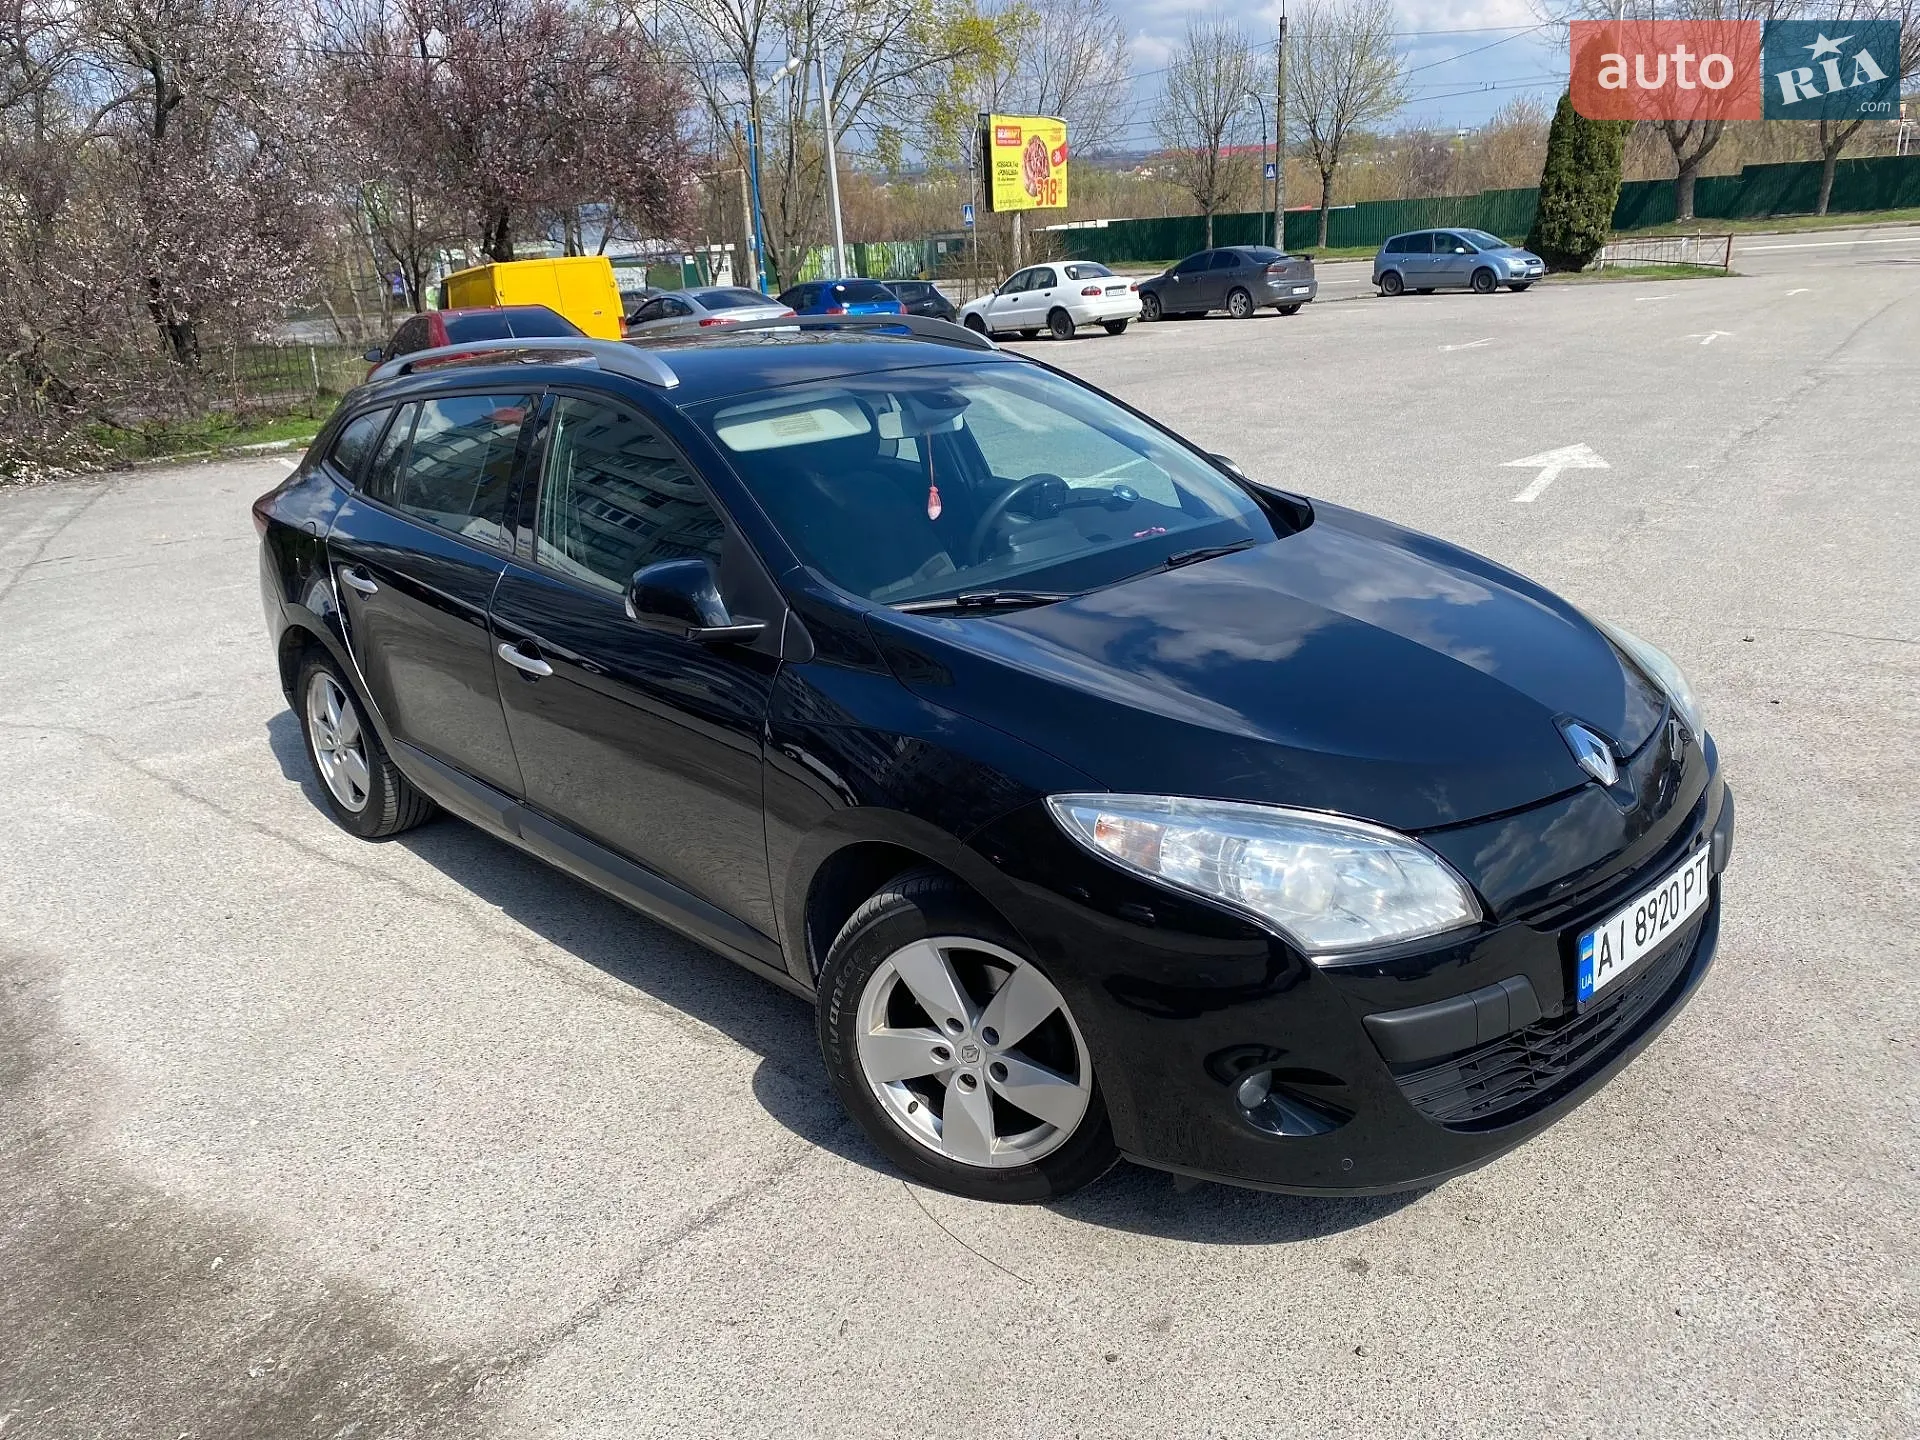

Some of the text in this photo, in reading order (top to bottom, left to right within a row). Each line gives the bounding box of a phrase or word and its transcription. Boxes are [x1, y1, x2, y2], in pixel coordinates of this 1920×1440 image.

[1036, 178, 1057, 206] 318
[1597, 854, 1707, 979] AI 8920 PT
[1581, 973, 1593, 990] UA
